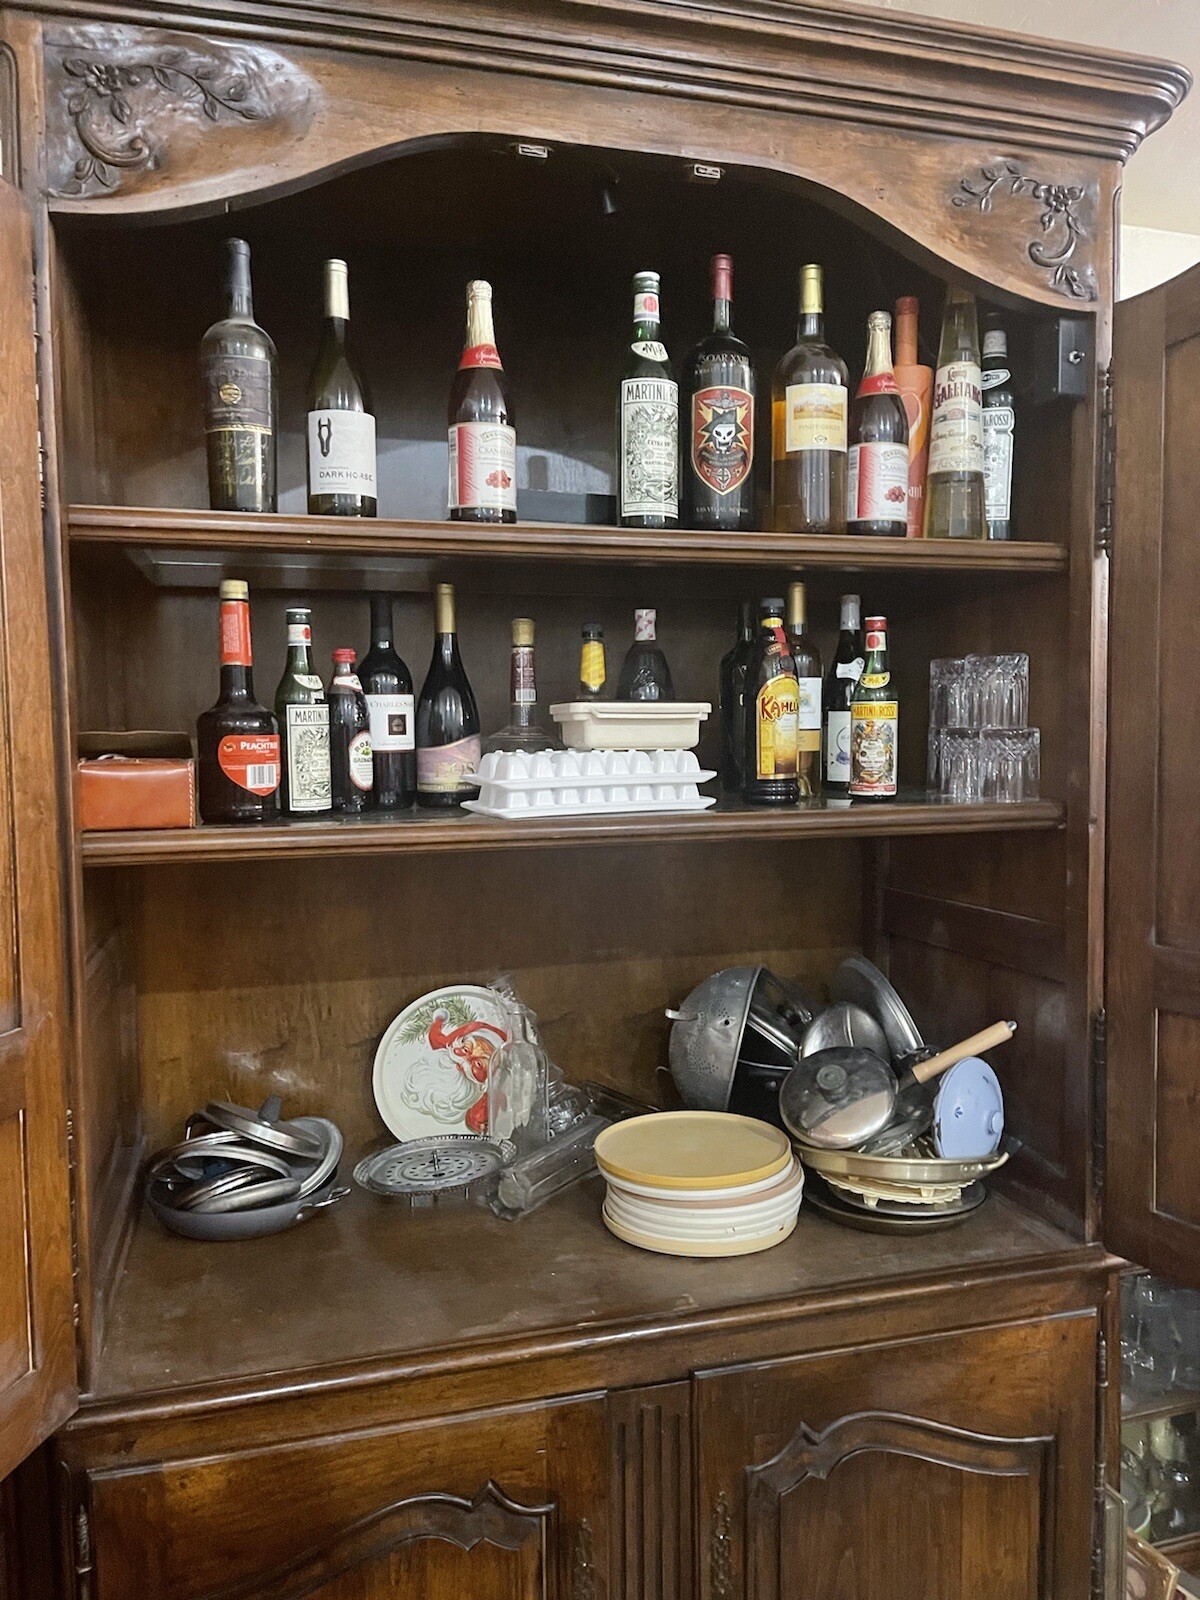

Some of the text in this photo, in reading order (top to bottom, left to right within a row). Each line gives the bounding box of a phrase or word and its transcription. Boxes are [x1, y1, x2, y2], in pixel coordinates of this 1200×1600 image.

[626, 383, 666, 402] MARTINI
[319, 470, 373, 483] DARK HORSE
